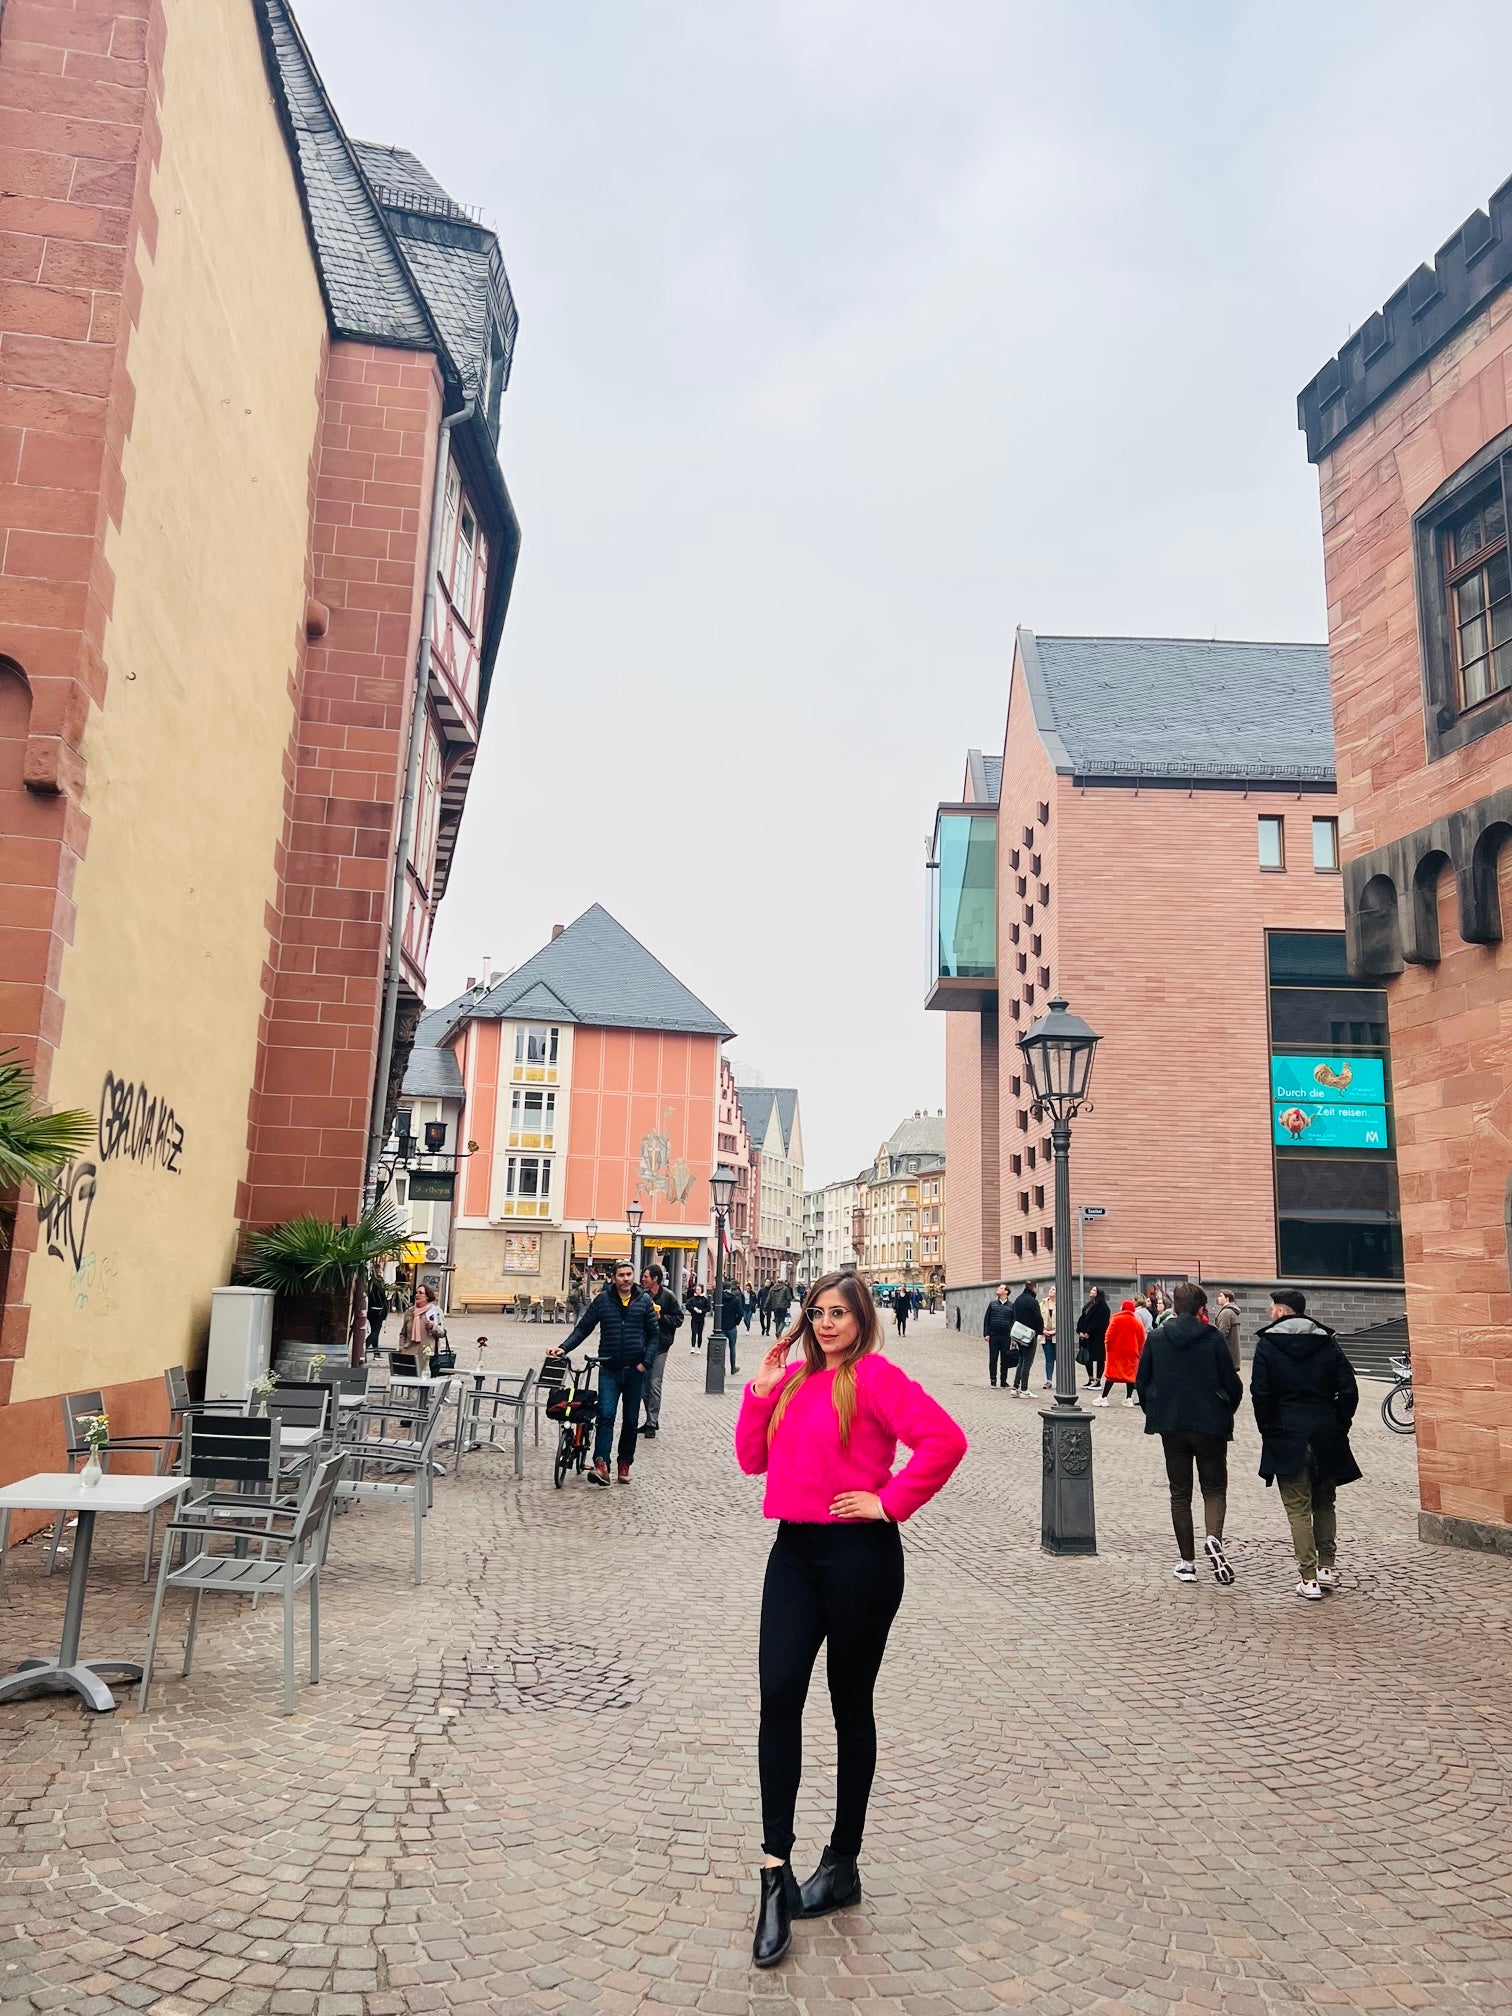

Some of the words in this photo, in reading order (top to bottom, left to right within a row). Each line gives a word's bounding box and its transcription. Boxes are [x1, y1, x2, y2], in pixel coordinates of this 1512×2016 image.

[1277, 1086, 1307, 1097] Durch
[1309, 1087, 1325, 1098] die
[1316, 1105, 1335, 1116] Zeit
